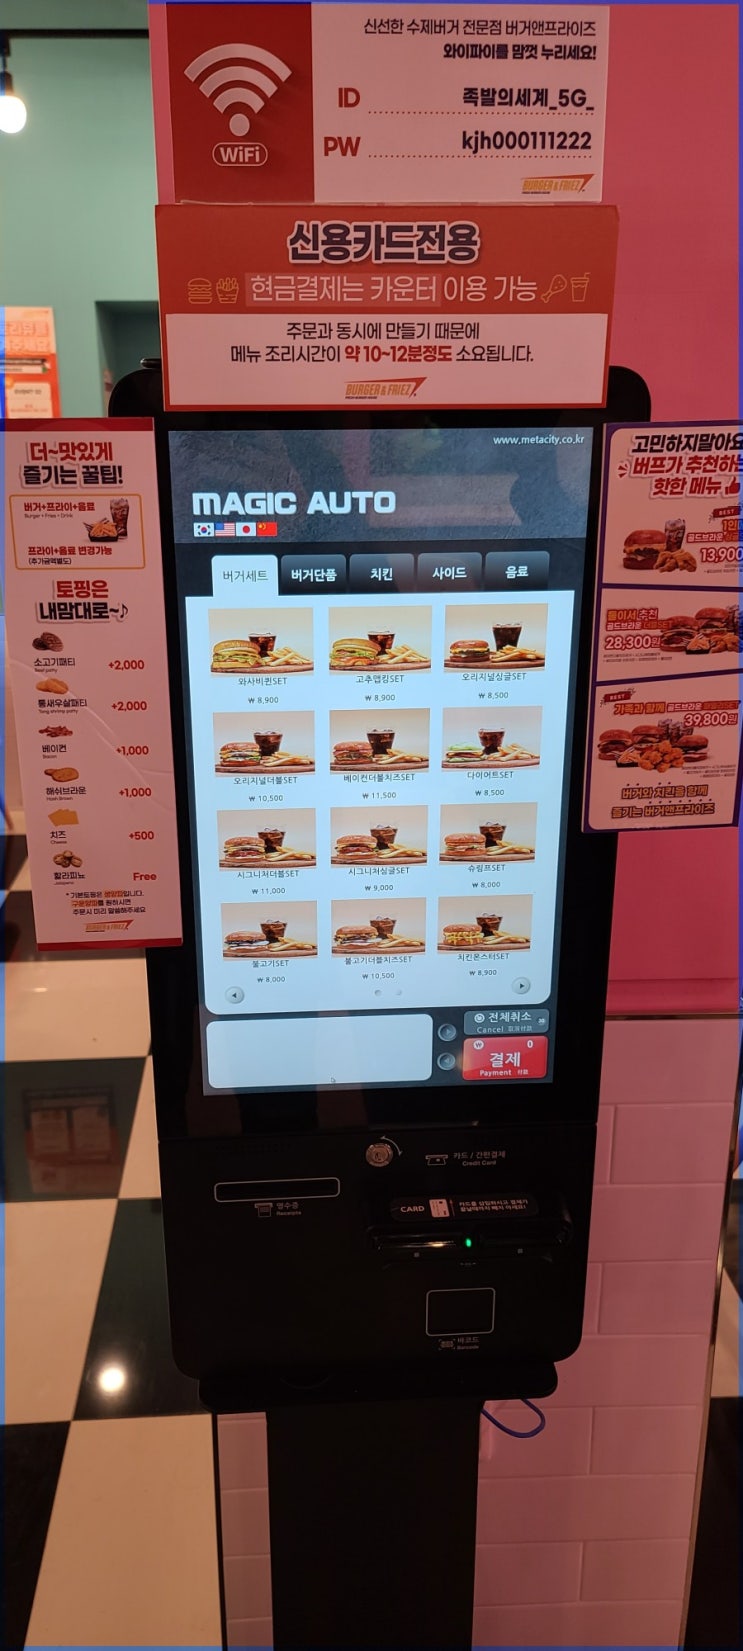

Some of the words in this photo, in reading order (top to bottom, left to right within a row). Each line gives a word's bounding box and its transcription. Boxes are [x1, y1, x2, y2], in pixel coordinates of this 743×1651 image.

[364, 18, 404, 35] 신선한
[406, 18, 459, 36] 수제버거
[463, 19, 500, 36] 전문점
[505, 19, 596, 37] 버거앤프라이즈
[443, 44, 508, 59] 와이파이를
[512, 44, 538, 60] 맘껏
[542, 45, 596, 60] 누리세요!
[338, 88, 360, 108] ID
[323, 137, 360, 156] PW
[462, 131, 591, 154] kjh000111222
[219, 145, 261, 162] WiFi
[288, 222, 480, 263] 신용카드전용
[251, 276, 363, 301] 현금결제는
[371, 276, 436, 301] 카운터
[443, 277, 487, 301] 이용
[493, 276, 537, 301] 가능
[287, 322, 332, 340] 주문과
[337, 322, 381, 340] 동시에
[385, 322, 431, 340] 만들기
[435, 322, 479, 340] 때문에
[231, 345, 262, 363] 메뉴
[265, 345, 340, 363] 조리시간이
[345, 346, 359, 363] 약
[363, 345, 453, 363] 10~12분정도
[456, 345, 534, 363] 소요됩니다.
[345, 383, 381, 396] BURGER
[492, 434, 585, 446] www.metacity.co.kr
[30, 442, 113, 461] 더~맛있게
[633, 455, 683, 475] 버프가
[24, 465, 77, 485] 즐기는
[82, 466, 123, 484] 꿀팁!
[653, 477, 688, 496] 핫한
[689, 476, 722, 495] 메뉴
[192, 491, 296, 515] MAGIC
[306, 491, 396, 515] AUTO
[688, 533, 723, 542] 골드브라운
[28, 545, 76, 556] 프라이+음료
[78, 545, 113, 556] 변경가능
[222, 569, 269, 582] 버거세트
[291, 567, 337, 582] 버거단품
[371, 567, 394, 581] 치킨
[433, 566, 467, 580] 사이드
[505, 565, 529, 578] 음료
[56, 579, 109, 598] 토핑은
[607, 609, 637, 621] 둘이서
[638, 609, 658, 620] 추천
[607, 621, 642, 631] 골드브라운
[606, 635, 661, 651] 28,300원
[34, 658, 76, 667] 소고기패티
[108, 660, 145, 671] +2,000
[462, 672, 527, 682] 오리지널싱글SET
[257, 696, 279, 704] 8,900
[374, 694, 396, 702] 8,900
[487, 691, 509, 700] 8,500
[38, 698, 88, 708] 통새우살패티
[111, 701, 147, 712] +2,000
[614, 702, 644, 714] 가족과
[645, 702, 665, 714] 함께
[684, 712, 738, 727] 39,800원
[42, 744, 67, 753] 베이컨
[116, 746, 149, 756] +1,000
[467, 771, 514, 780] 다이어트SET
[46, 786, 87, 796] 해쉬브라운
[119, 787, 151, 798] +1,000
[372, 792, 397, 800] 11,500
[484, 789, 505, 797] 8,500
[622, 787, 652, 799] 버거와
[654, 786, 685, 798] 치킨을
[687, 785, 709, 797] 함께
[259, 794, 284, 803] 10,500
[612, 806, 642, 818] 즐기는
[644, 803, 715, 817] 버거앤프라이즈
[50, 830, 67, 839] 치즈
[129, 831, 154, 841] +500
[468, 864, 506, 873] 슈림프SET
[54, 872, 85, 881] 할라피뇨
[133, 872, 157, 881] Free
[373, 884, 394, 892] 9,000
[480, 880, 501, 888] 8,000
[261, 887, 286, 895] 11,000
[457, 952, 510, 962] 치킨몬스터SET
[252, 960, 289, 968] 불고기SET
[371, 972, 395, 980] 10,500
[477, 969, 497, 977] 8,900
[488, 1011, 532, 1023] 전체취소
[476, 1025, 504, 1034] Cancel
[526, 1039, 534, 1049] 0
[490, 1051, 521, 1068] 결제
[479, 1069, 512, 1078] Payment
[453, 1151, 469, 1159] 카드
[276, 1201, 299, 1210] 영수증
[400, 1205, 425, 1213] CARD
